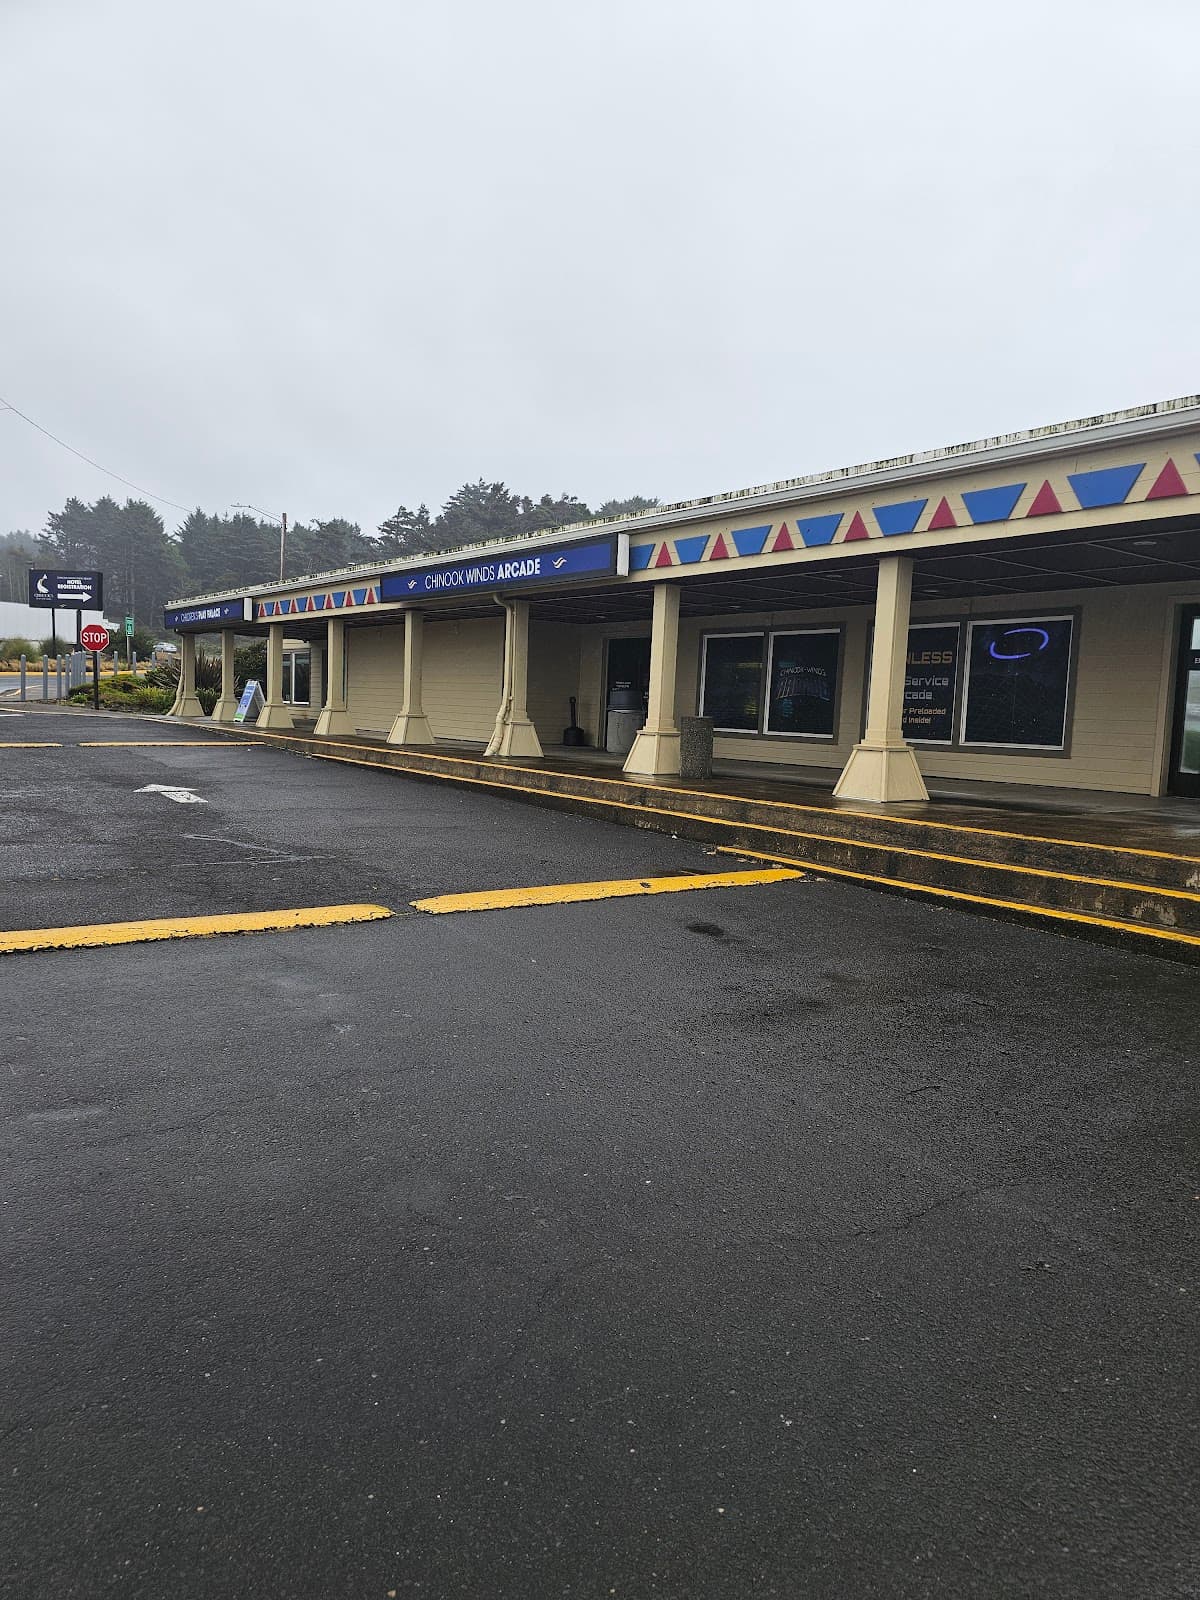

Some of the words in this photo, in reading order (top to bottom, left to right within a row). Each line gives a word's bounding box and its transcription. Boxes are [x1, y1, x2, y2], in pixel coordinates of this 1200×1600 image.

[425, 571, 465, 590] CHINOOK
[466, 565, 495, 584] WINDS
[497, 557, 541, 580] ARCADE
[82, 632, 107, 643] STOP
[904, 675, 949, 687] Service
[908, 707, 947, 715] Preloaded
